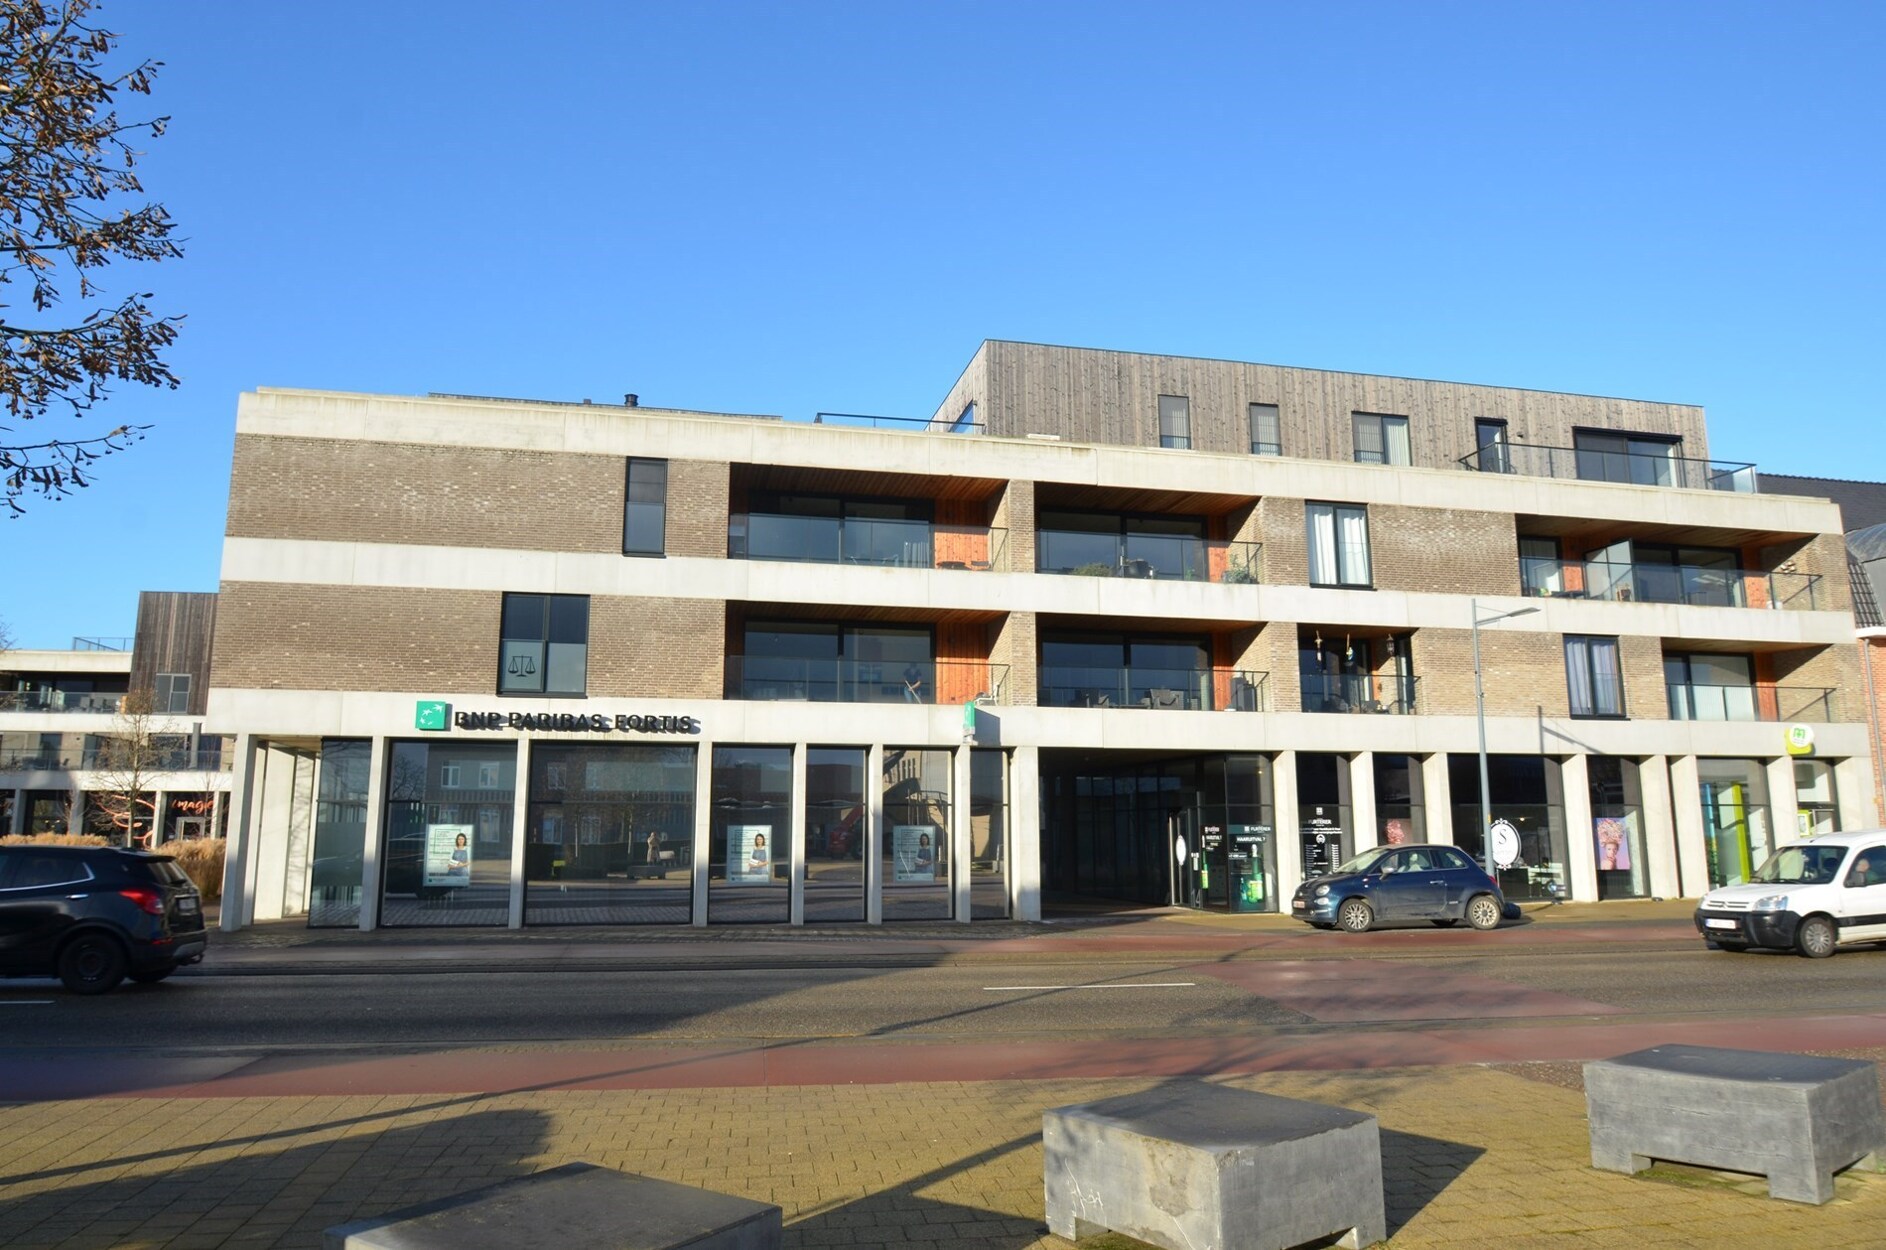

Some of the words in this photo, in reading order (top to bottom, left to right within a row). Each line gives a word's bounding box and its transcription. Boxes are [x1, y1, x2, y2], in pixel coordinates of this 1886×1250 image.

[454, 711, 500, 729] BNP
[508, 712, 602, 731] PARIBAS
[614, 714, 692, 733] FORTIS
[1498, 828, 1507, 845] S
